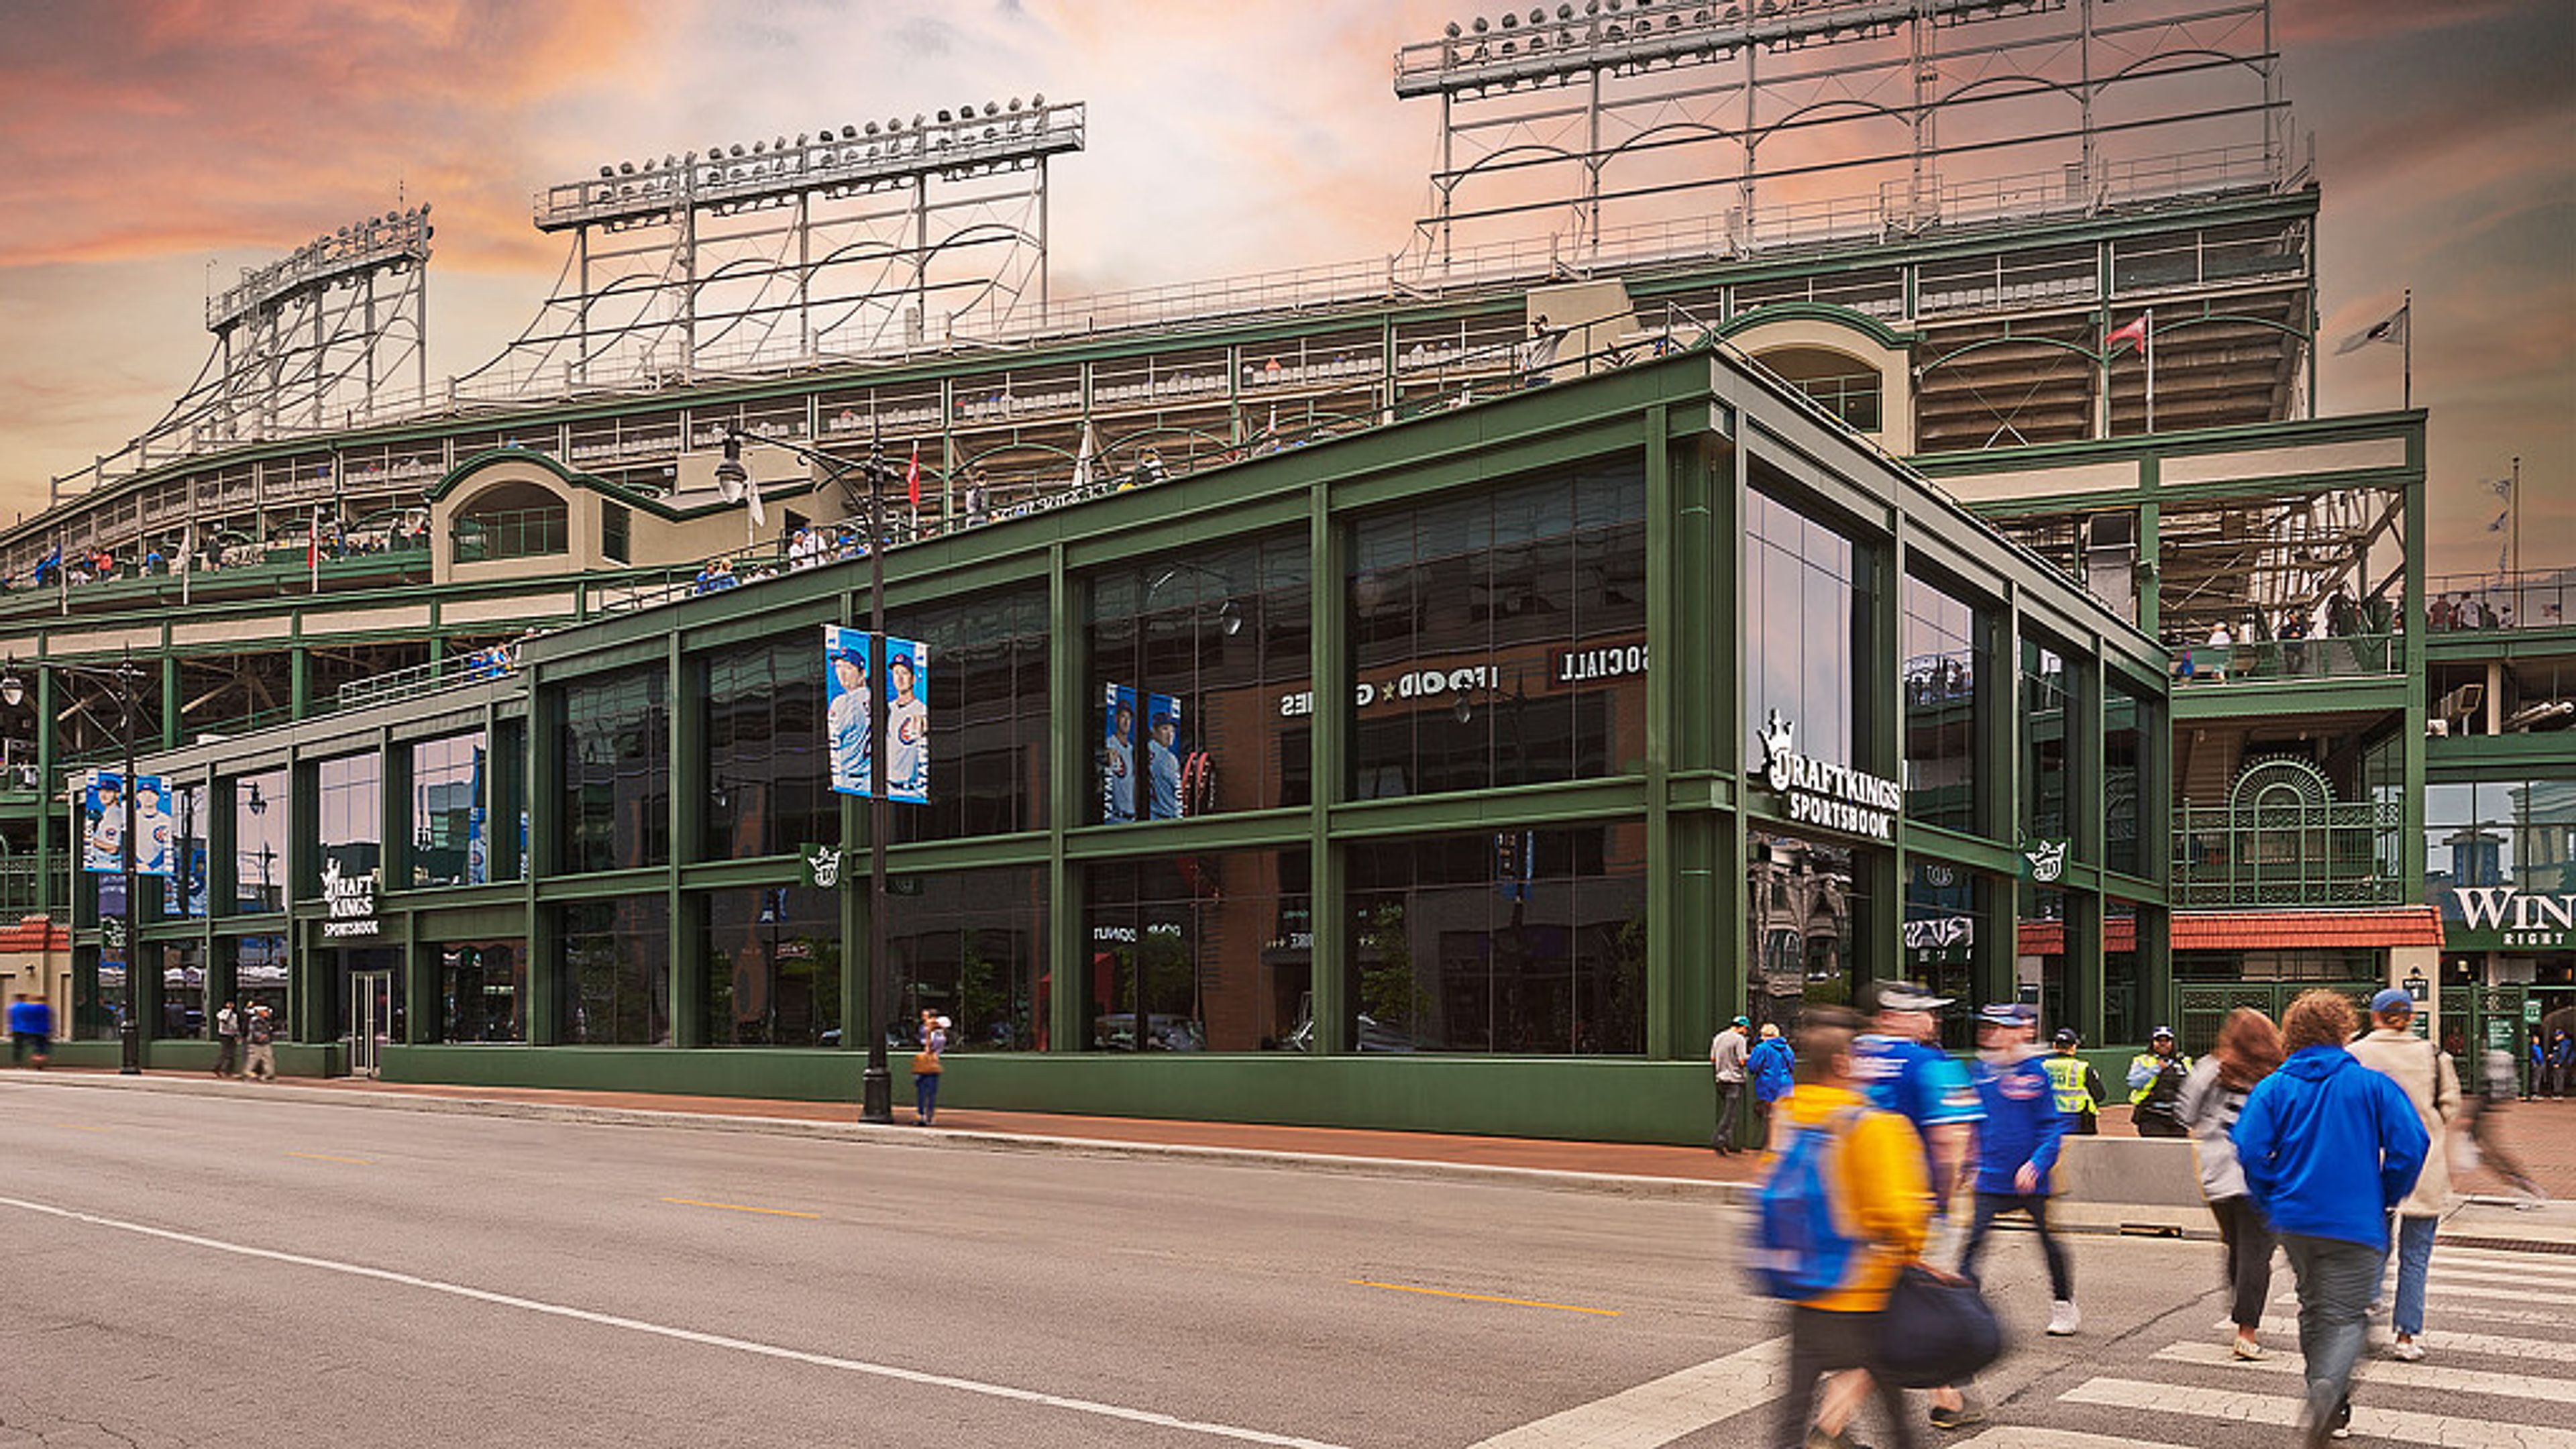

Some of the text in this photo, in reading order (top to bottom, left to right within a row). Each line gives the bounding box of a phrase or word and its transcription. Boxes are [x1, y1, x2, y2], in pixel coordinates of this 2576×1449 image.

[1770, 749, 1900, 811] DRAFTKINGS
[1790, 793, 1889, 839] SPORTSBOOK
[324, 875, 373, 902] DRAFT
[329, 896, 373, 918] KINGS
[2453, 887, 2576, 931] WIN
